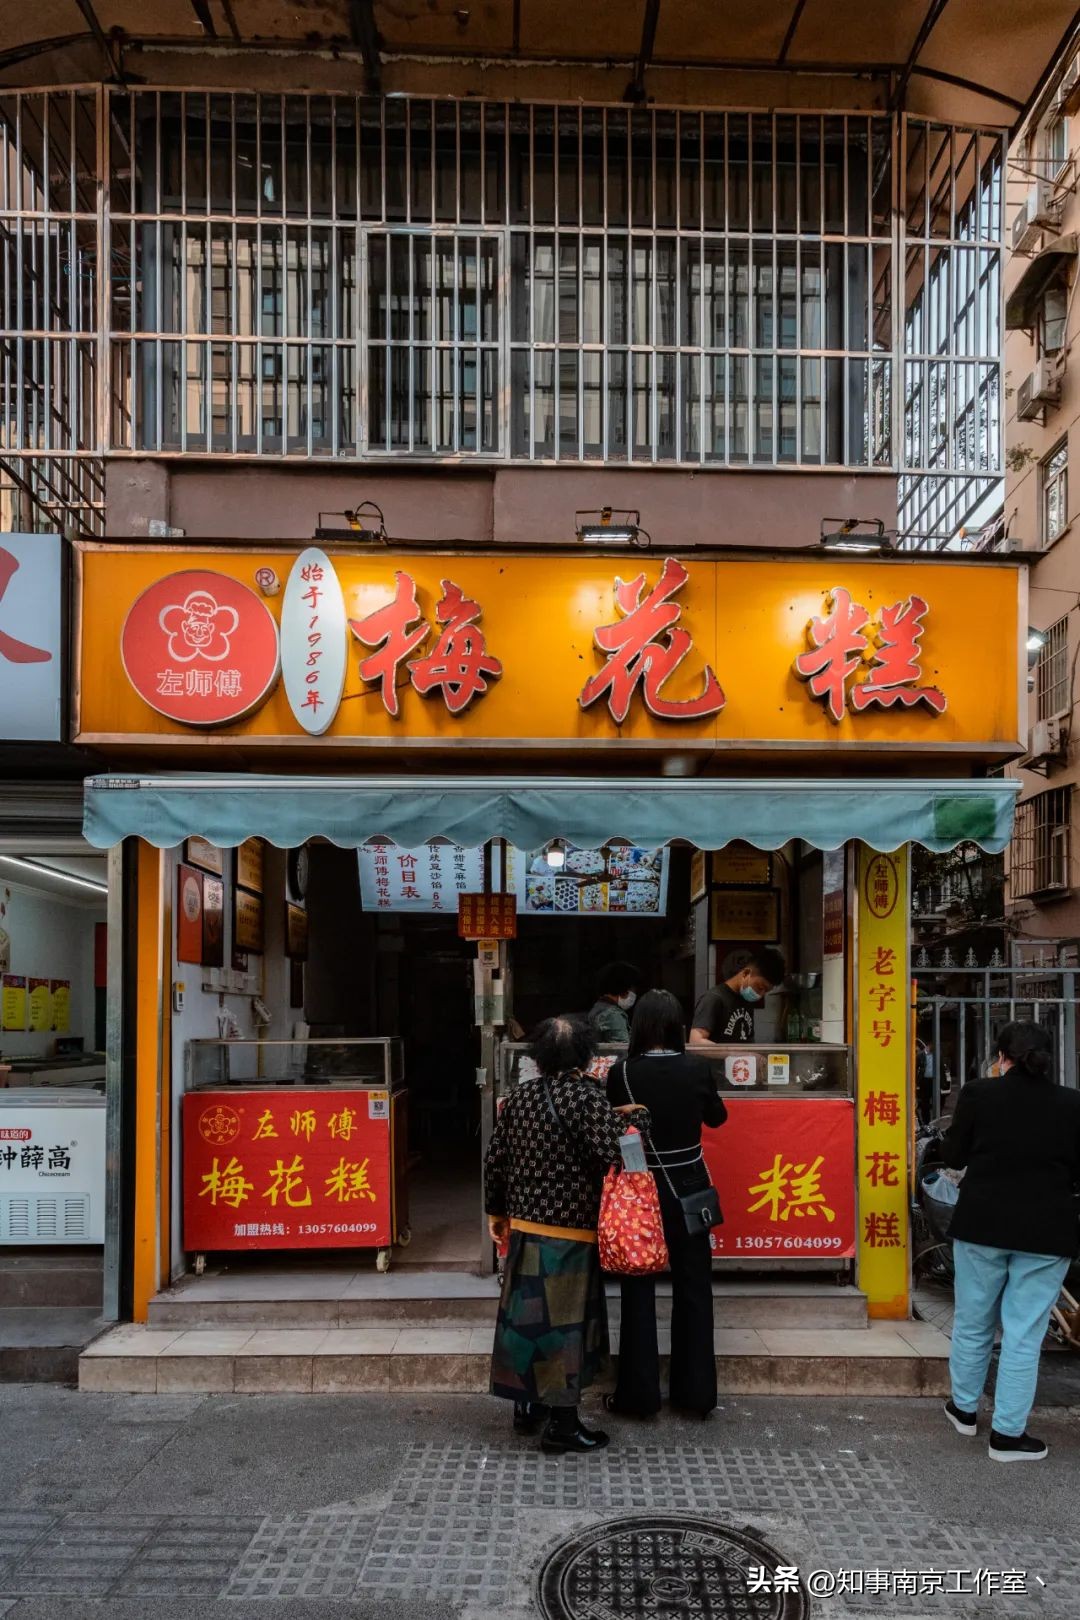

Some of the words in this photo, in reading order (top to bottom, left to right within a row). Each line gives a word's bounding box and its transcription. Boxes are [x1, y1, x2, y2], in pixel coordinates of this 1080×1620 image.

[300, 563, 325, 713] 始于1986年
[348, 556, 948, 724] 梅花糕
[156, 670, 242, 698] 左师傅
[397, 854, 421, 899] 价目表
[873, 863, 889, 910] 左师傅
[869, 946, 897, 1047] 老字号
[252, 1107, 358, 1143] 左师傅
[198, 1154, 377, 1208] 梅花糕
[747, 1154, 836, 1222] 糕
[863, 1090, 901, 1248] 梅花糕
